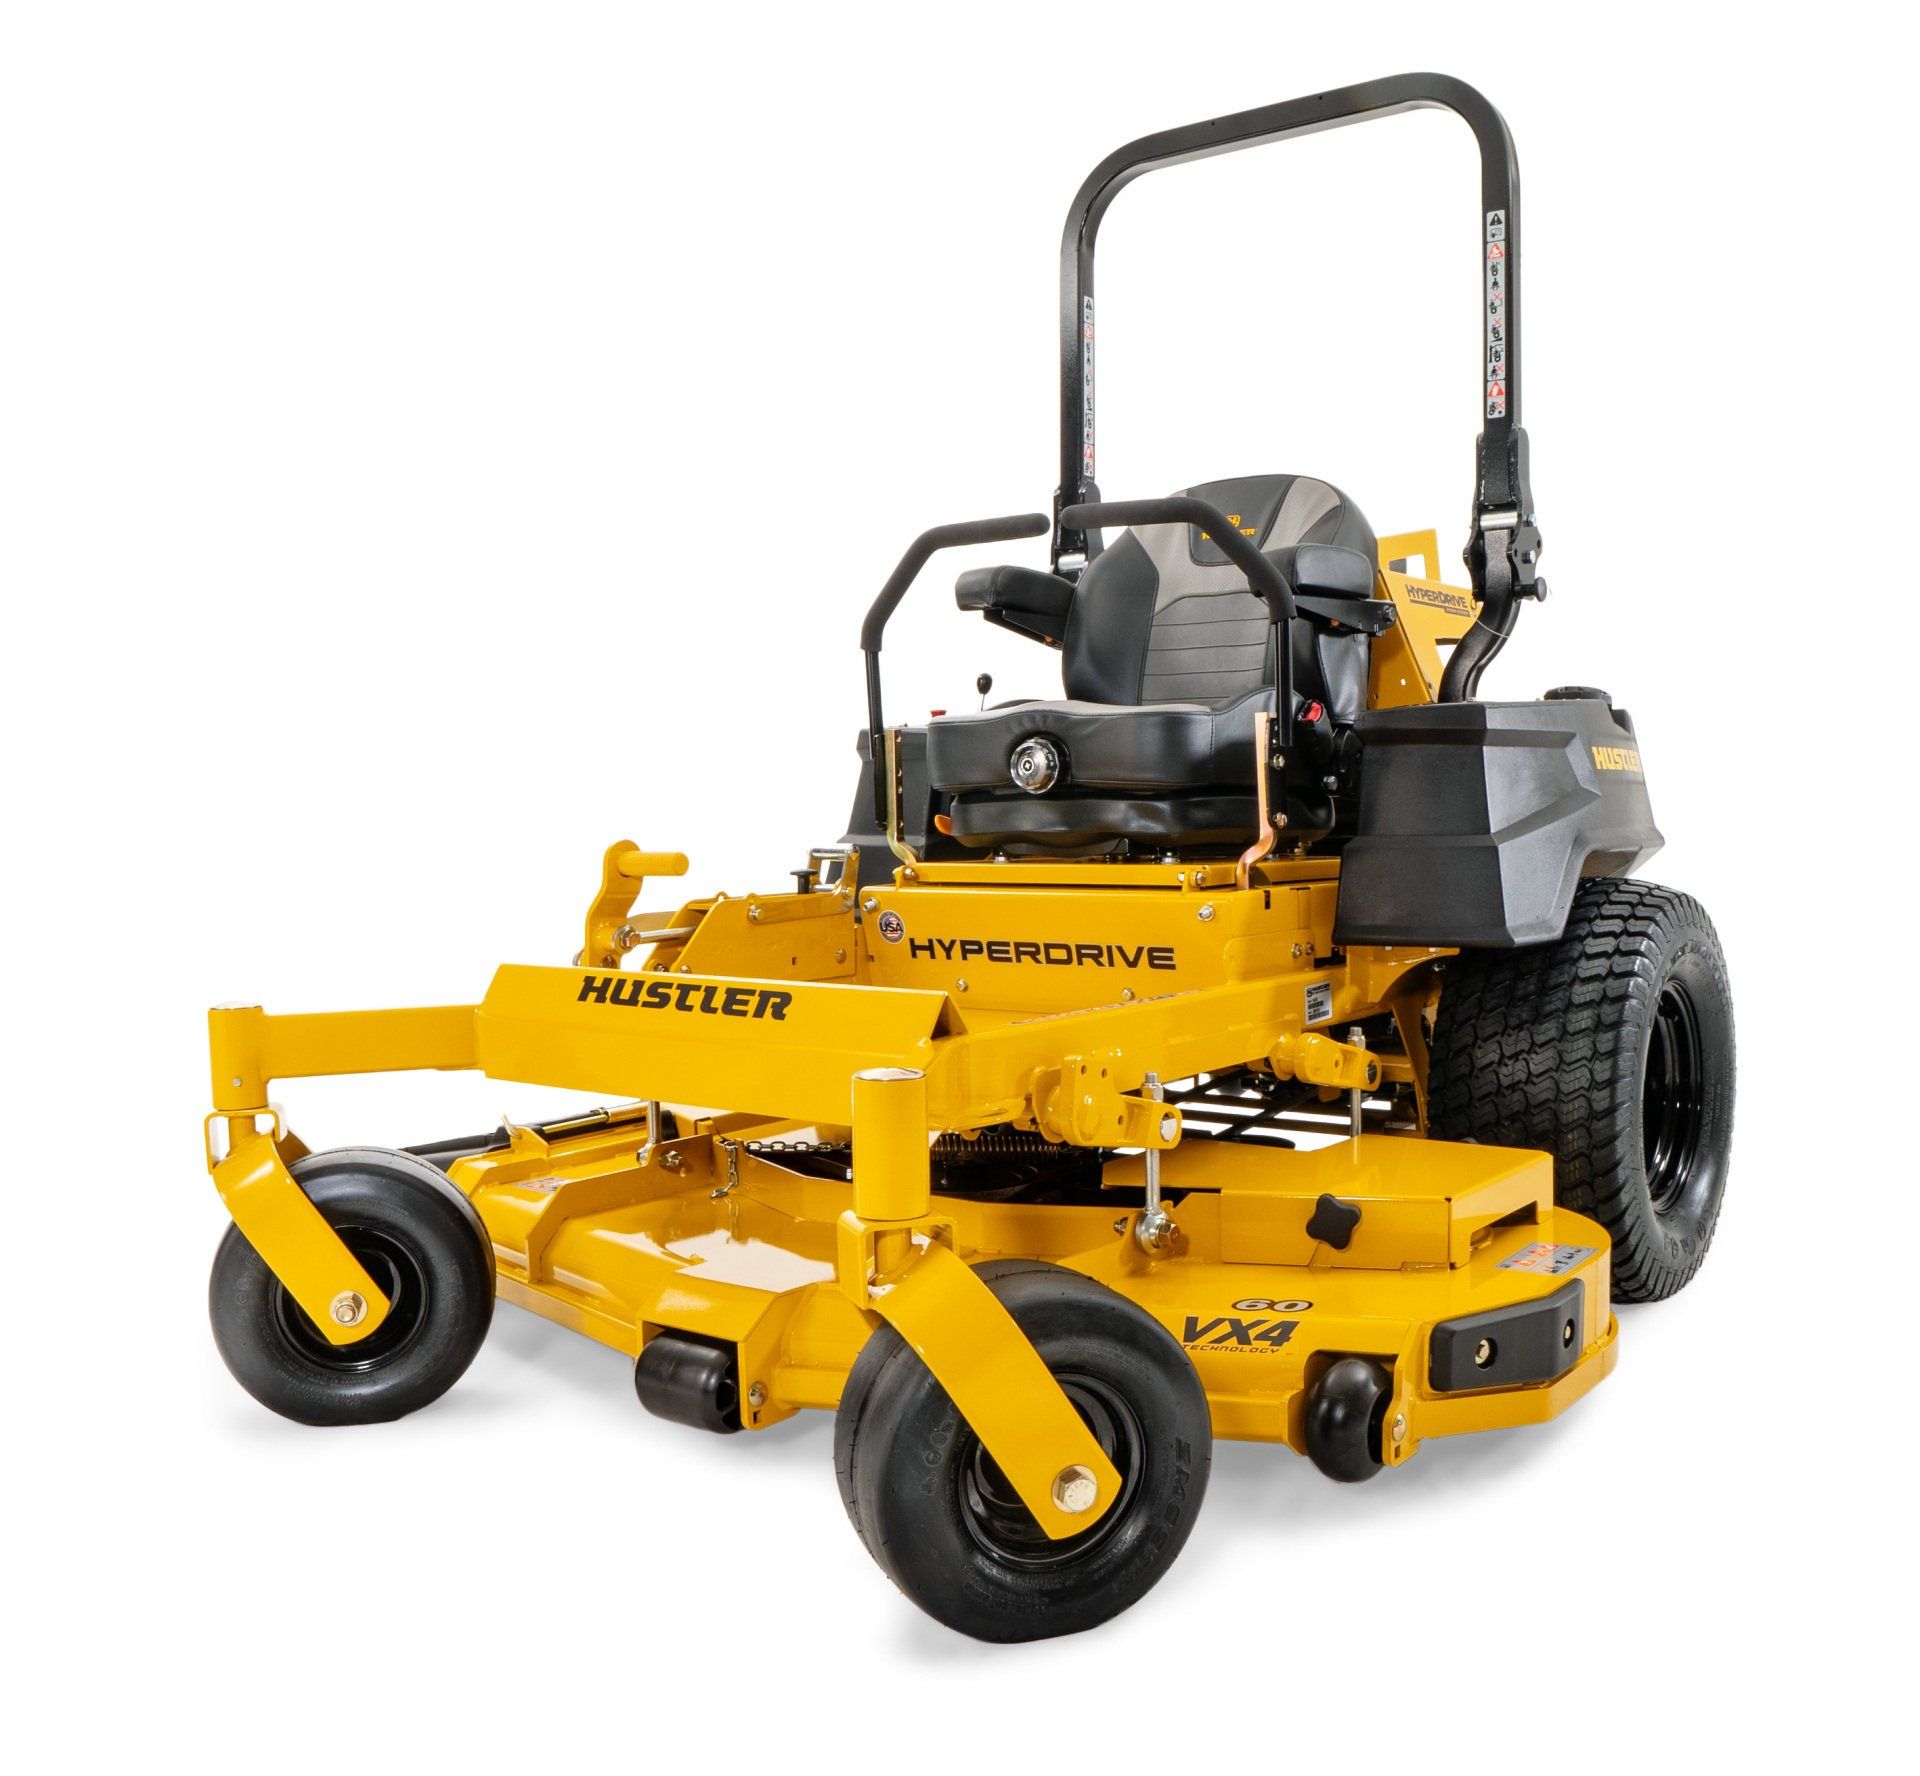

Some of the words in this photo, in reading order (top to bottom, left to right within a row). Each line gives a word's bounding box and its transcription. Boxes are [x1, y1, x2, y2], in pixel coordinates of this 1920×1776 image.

[1405, 584, 1468, 607] HYPERDRIVE
[880, 921, 904, 933] USA
[909, 938, 1177, 971] HYPERDRIVE
[577, 975, 793, 1021] HUSTLER
[1231, 1298, 1314, 1313] 60
[1183, 1316, 1301, 1347] VX4
[1183, 1344, 1280, 1354] TECHNOLOGY
